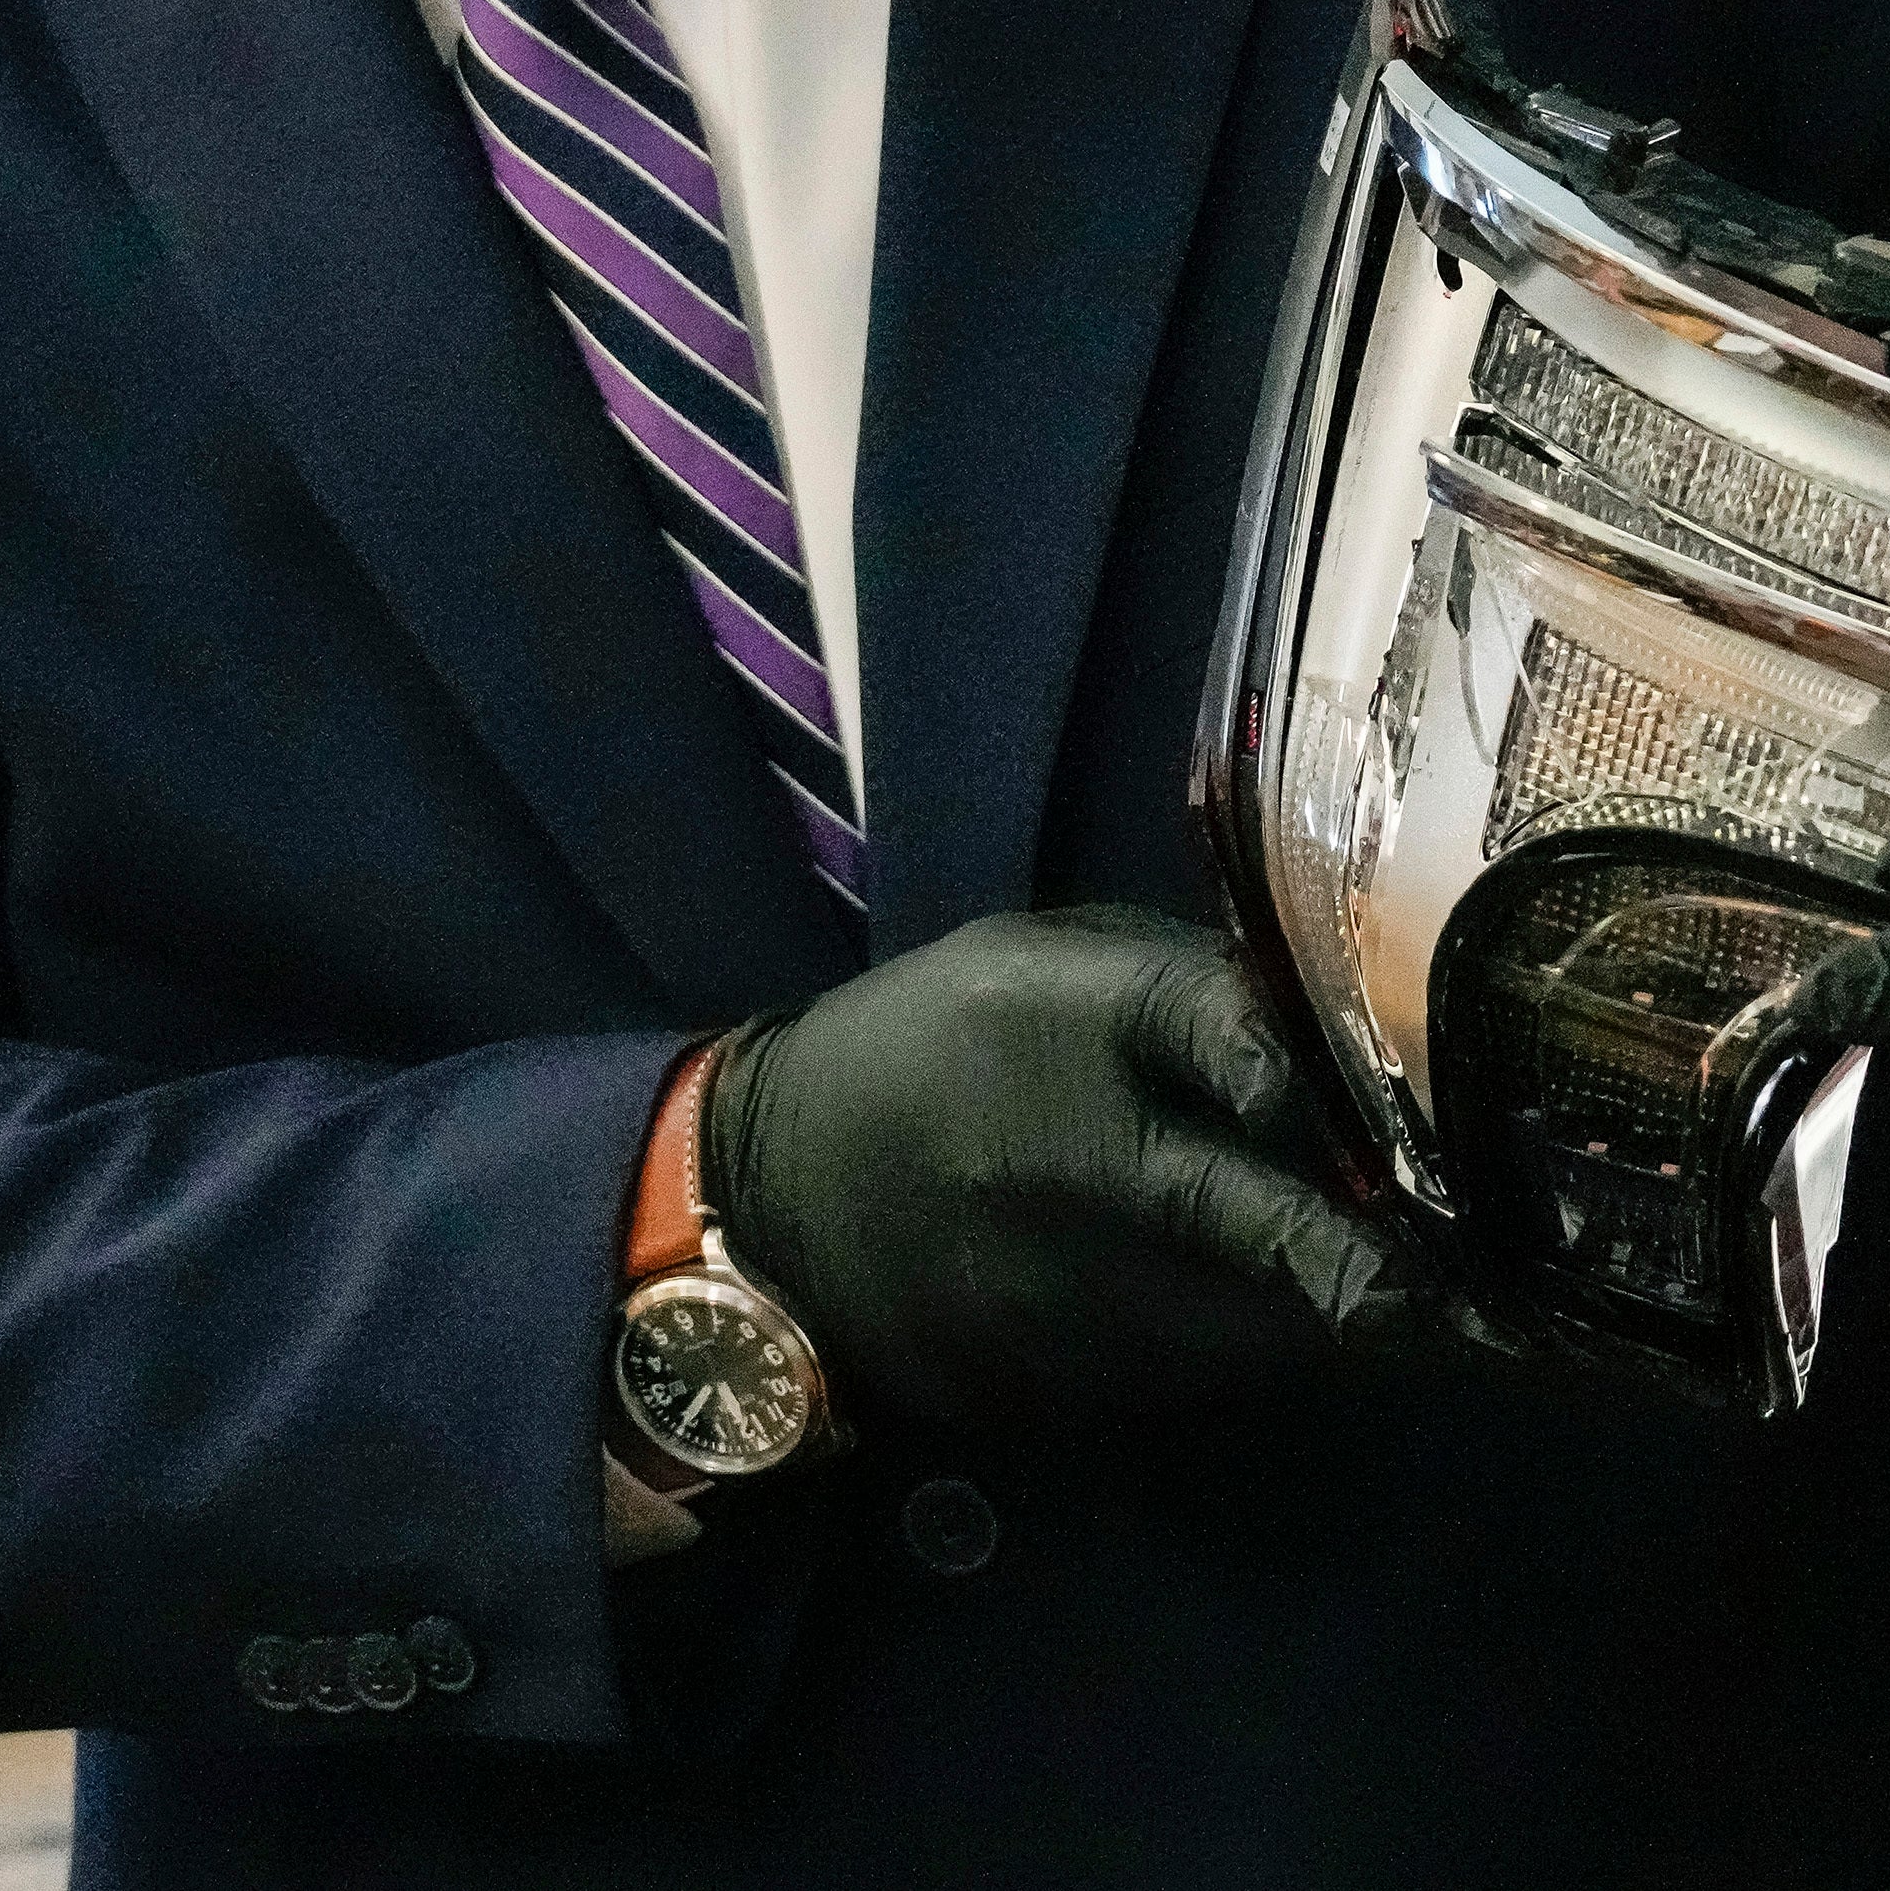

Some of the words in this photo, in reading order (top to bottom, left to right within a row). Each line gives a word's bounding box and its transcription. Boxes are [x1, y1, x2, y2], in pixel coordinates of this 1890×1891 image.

[674, 1309, 694, 1330] 6
[763, 1343, 785, 1365] 9
[769, 1375, 793, 1397] 10
[767, 1402, 785, 1421] 11
